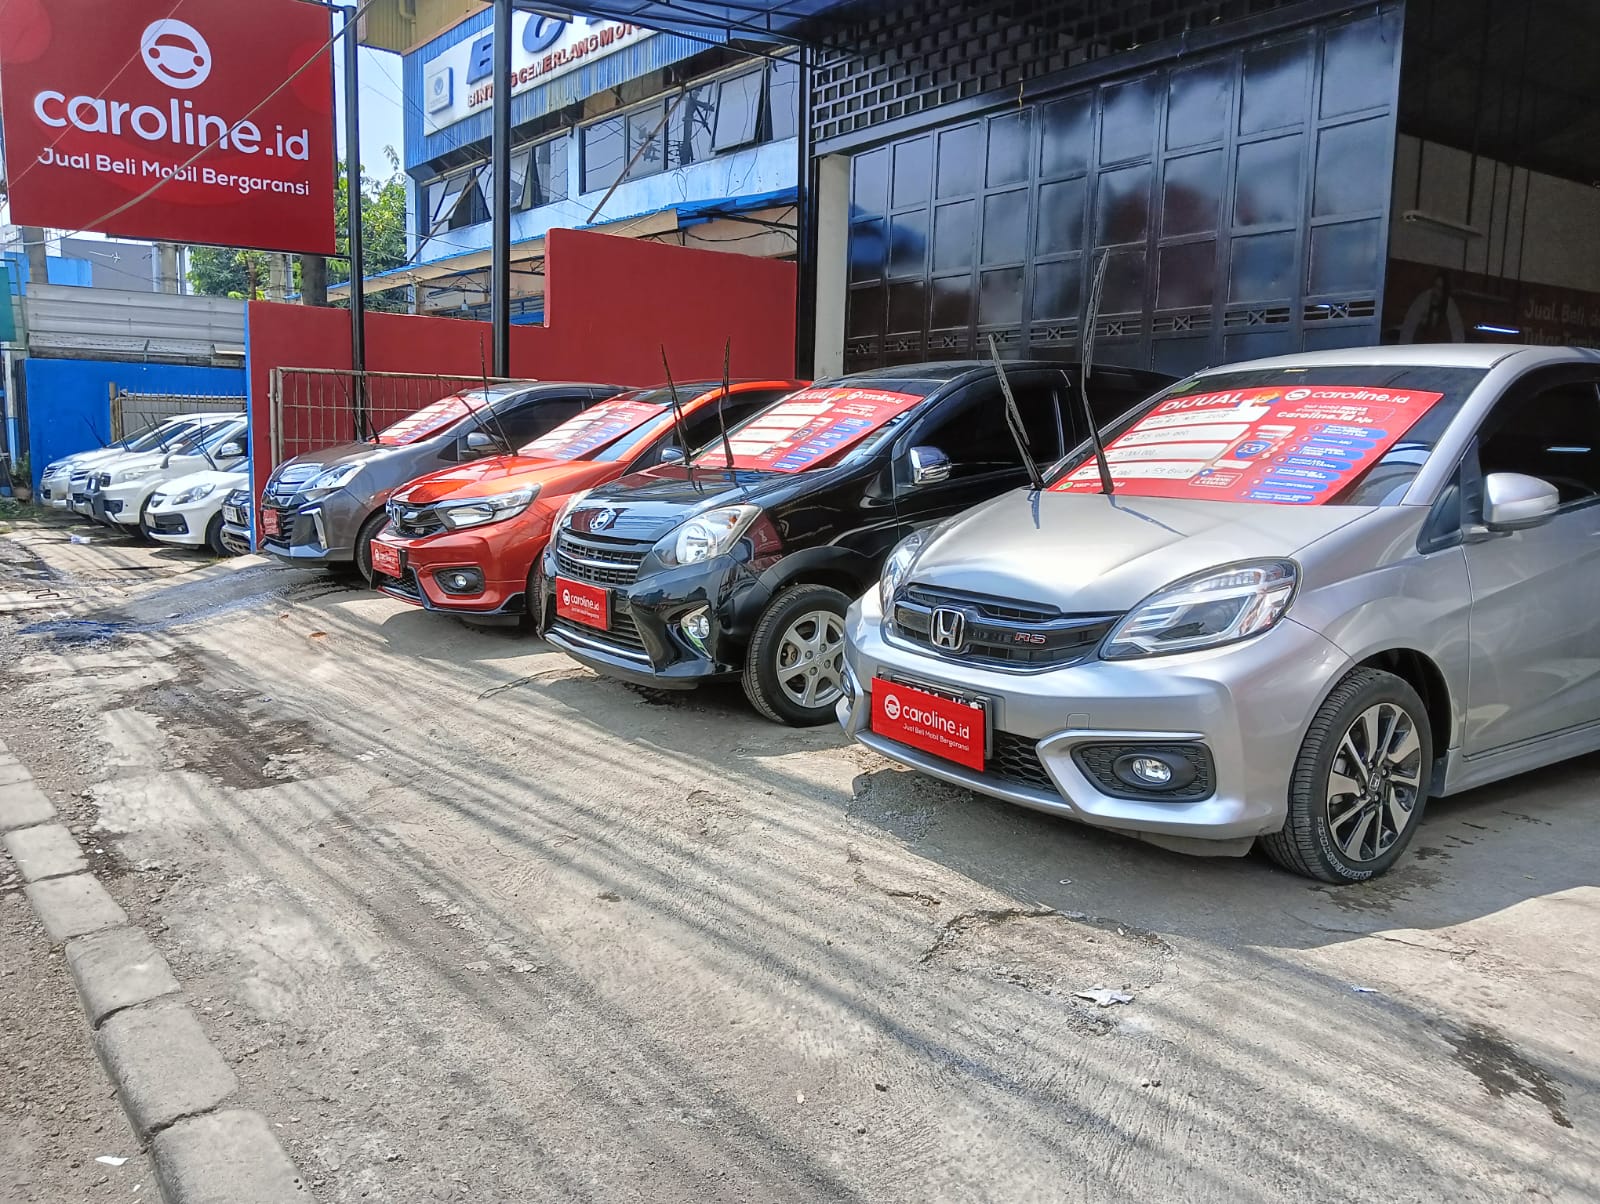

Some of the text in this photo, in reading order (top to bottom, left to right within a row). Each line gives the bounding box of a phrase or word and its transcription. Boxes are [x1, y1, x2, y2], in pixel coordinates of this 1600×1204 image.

[33, 89, 310, 161] caroline.id
[37, 147, 310, 195] Jual Beli Mobil Bergaransi
[1159, 392, 1243, 412] DIJUAL
[1311, 390, 1411, 404] caroline.id
[1014, 632, 1047, 644] RS
[902, 705, 970, 740] caroline.id
